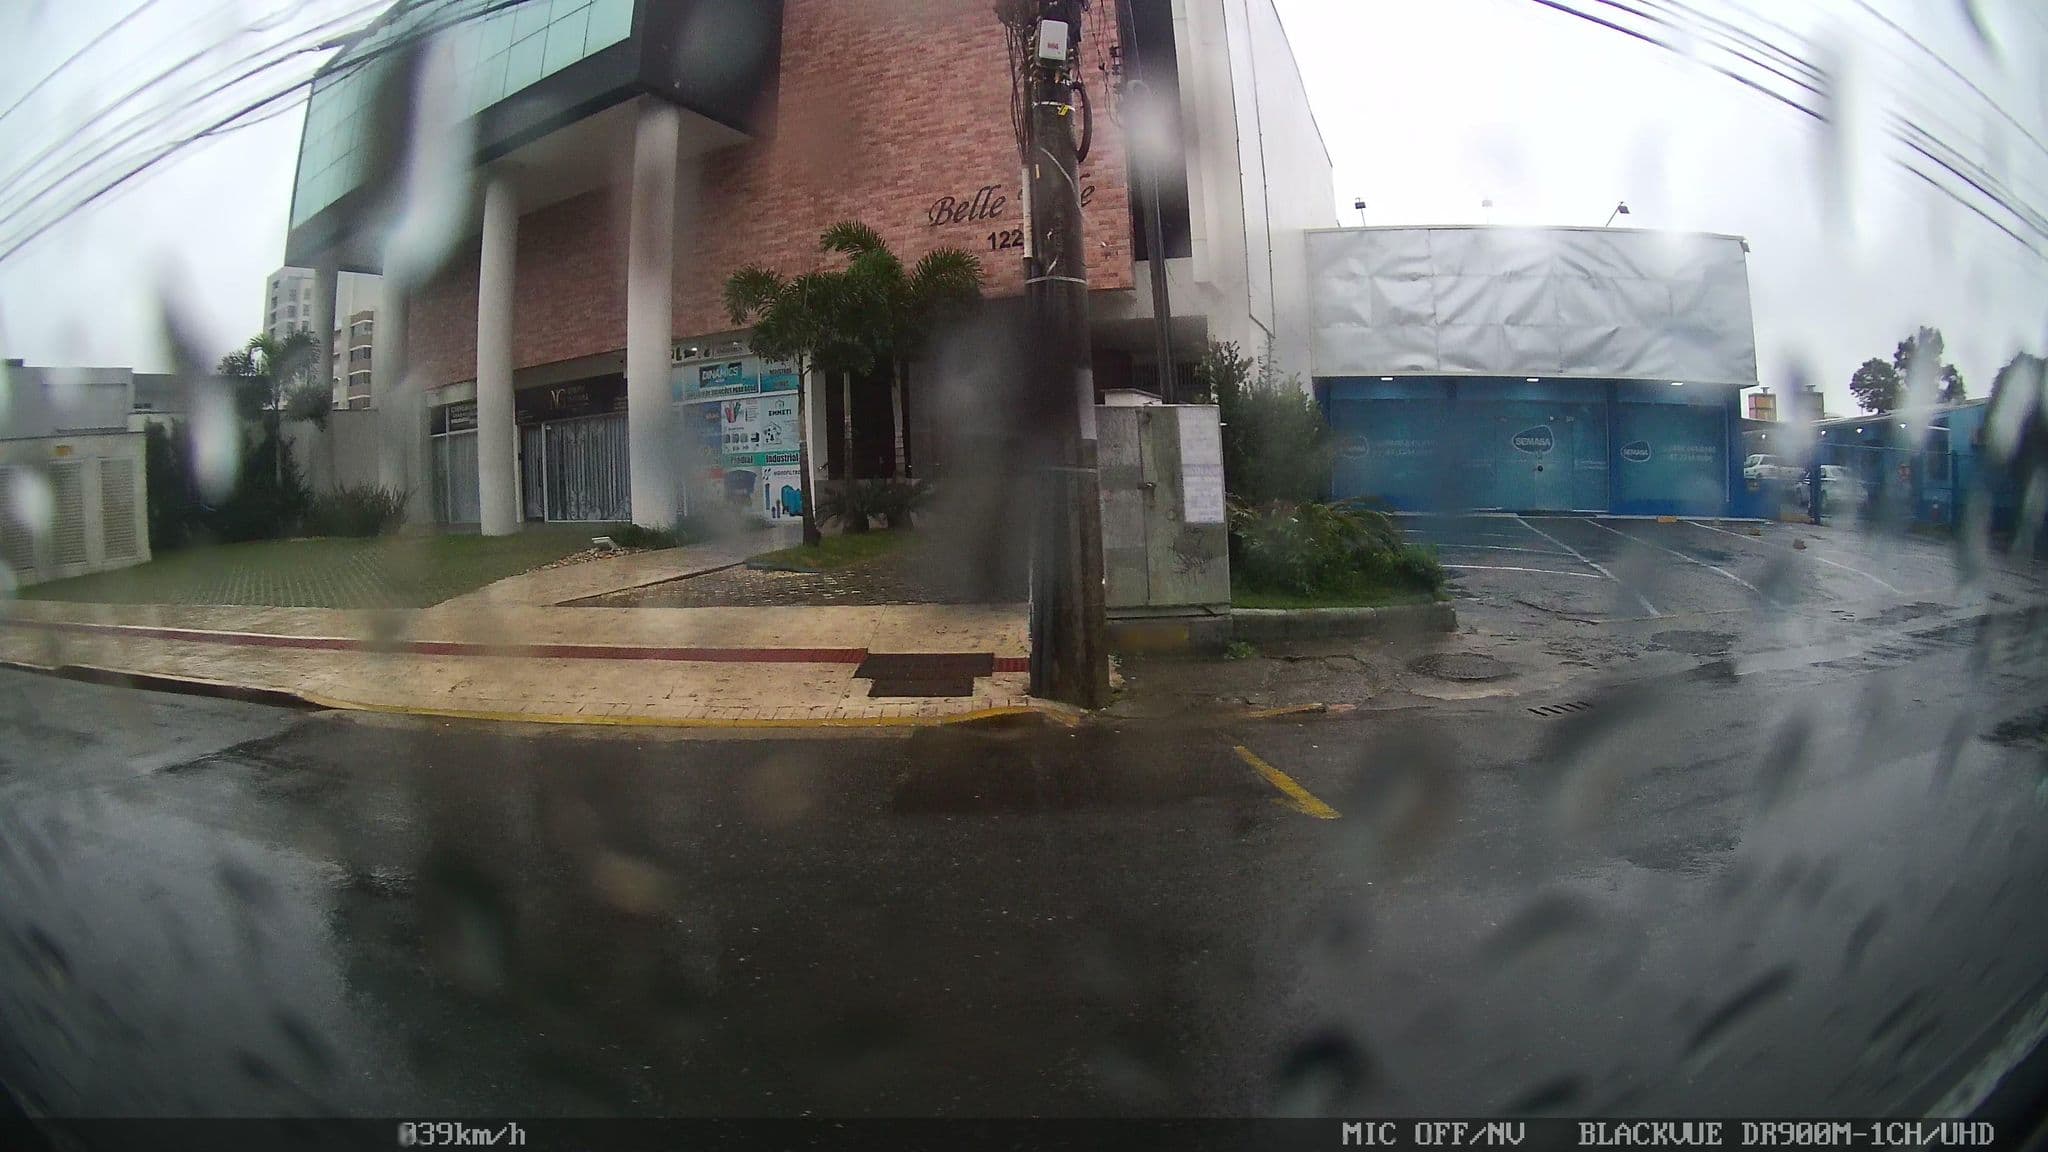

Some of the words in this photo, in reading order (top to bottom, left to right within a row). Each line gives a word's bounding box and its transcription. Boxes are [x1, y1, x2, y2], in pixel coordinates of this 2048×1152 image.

[928, 184, 1006, 226] Belle
[1515, 437, 1550, 446] SEMASA
[766, 453, 799, 463] Industrial
